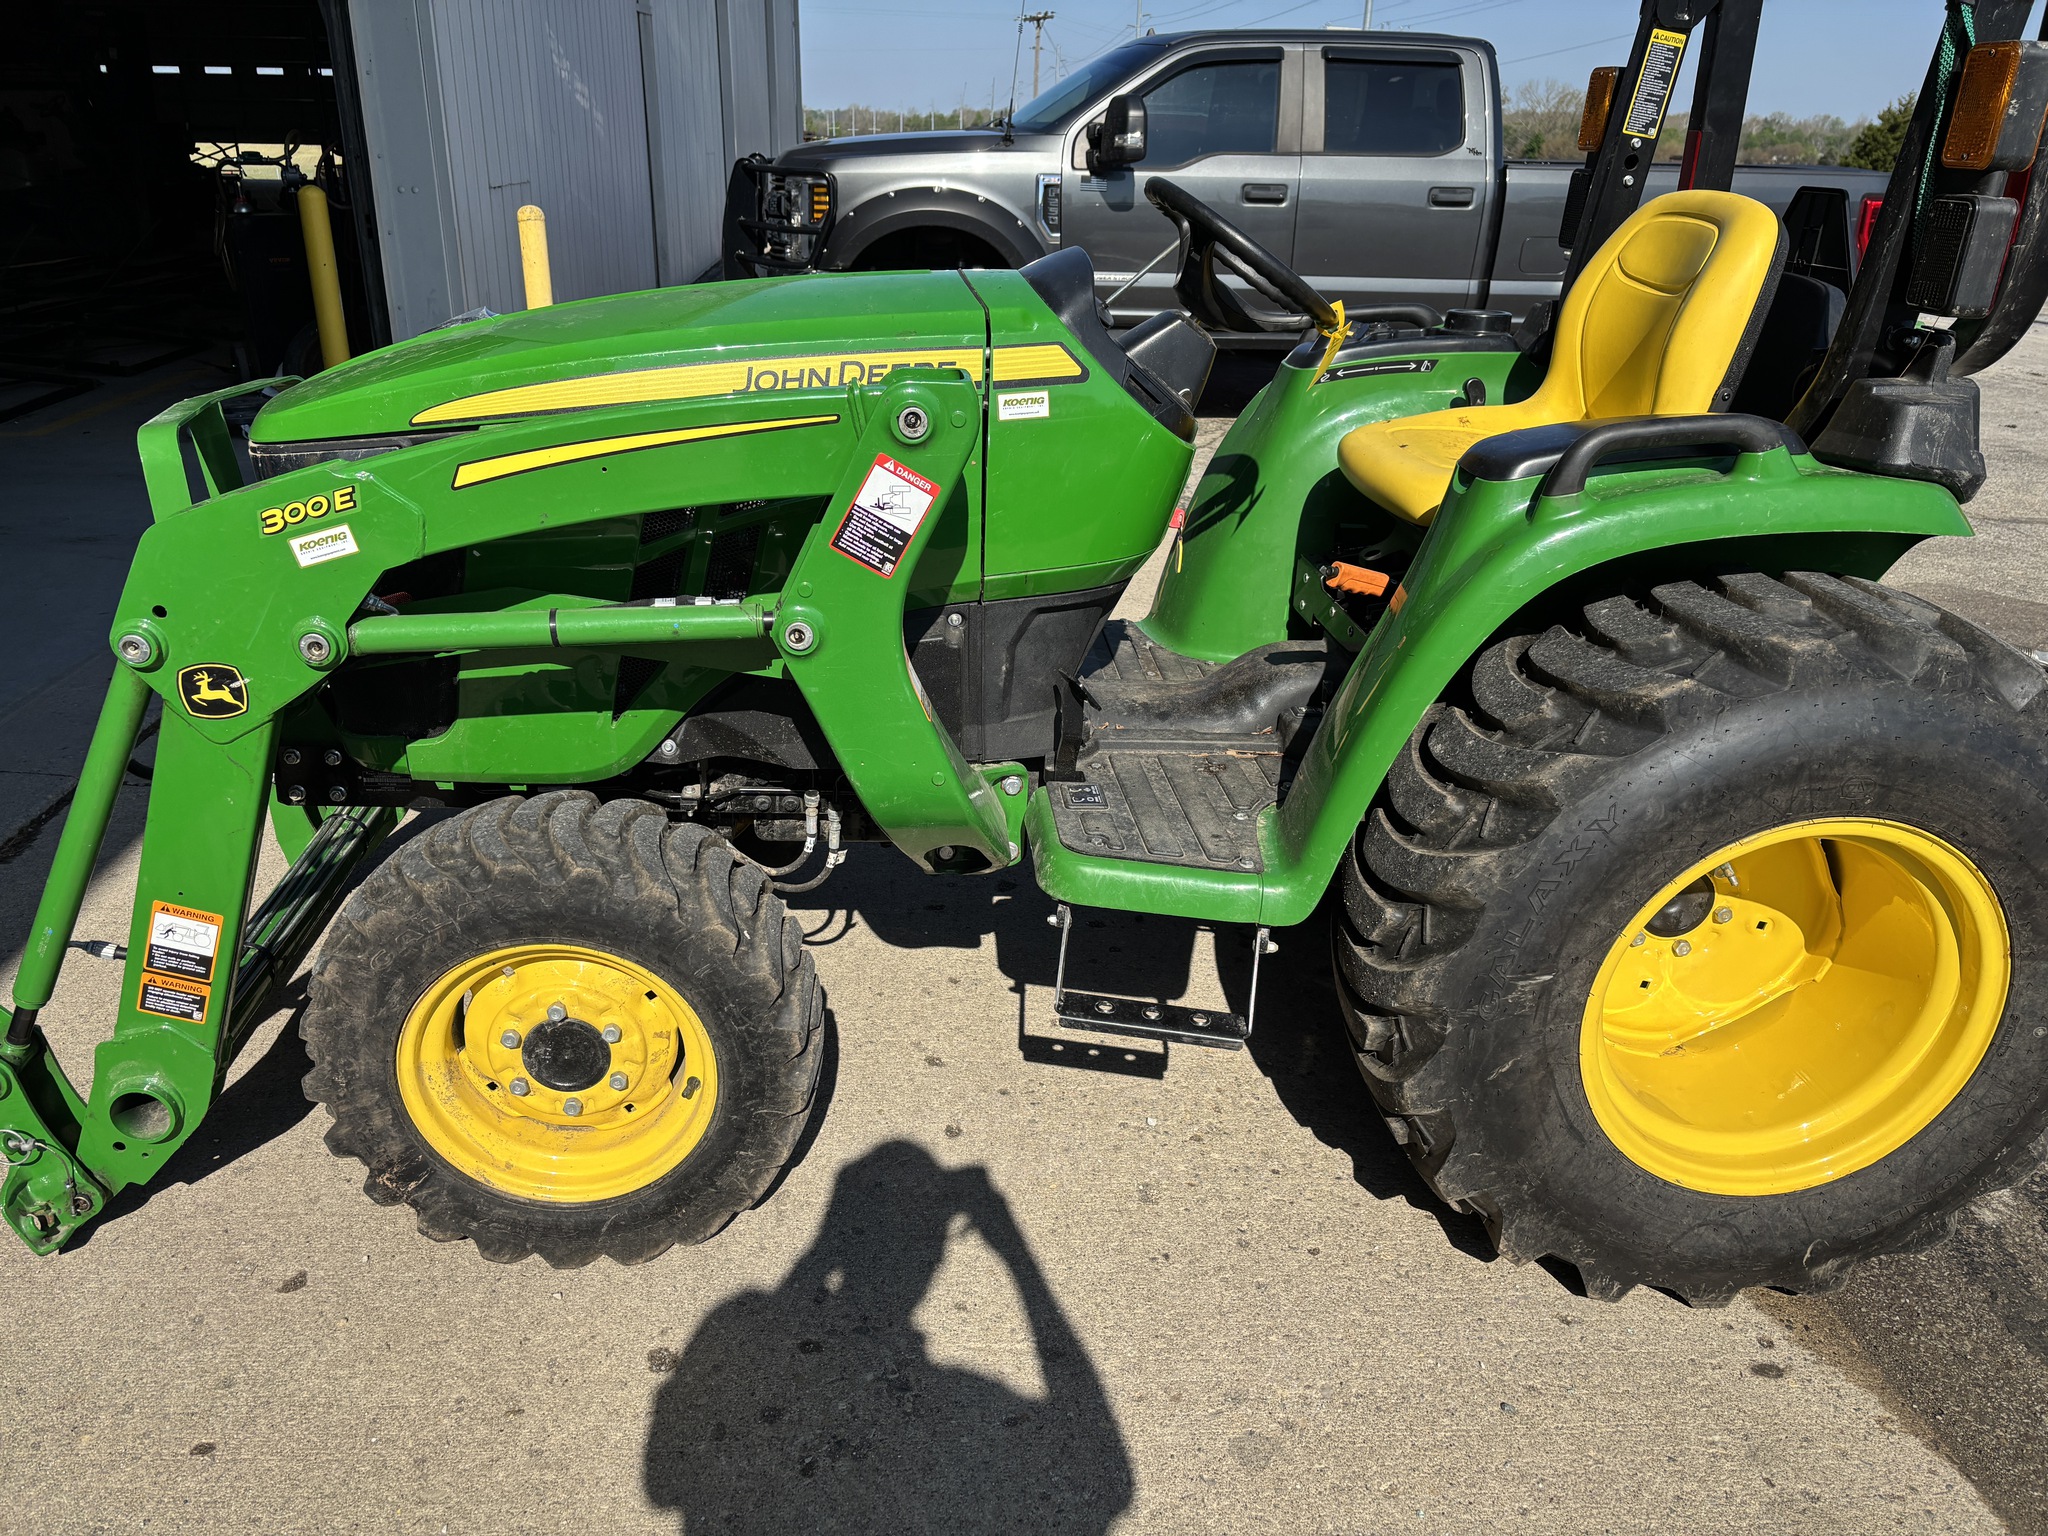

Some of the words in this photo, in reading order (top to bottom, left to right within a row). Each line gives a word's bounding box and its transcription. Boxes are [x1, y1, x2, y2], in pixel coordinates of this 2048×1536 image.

[1659, 34, 1685, 45] CAUTION
[732, 366, 831, 393] JOHN
[895, 466, 932, 492] DANGER
[171, 907, 216, 923] WARNING
[1478, 800, 1620, 1022] GALAXY
[161, 978, 203, 994] WARNING
